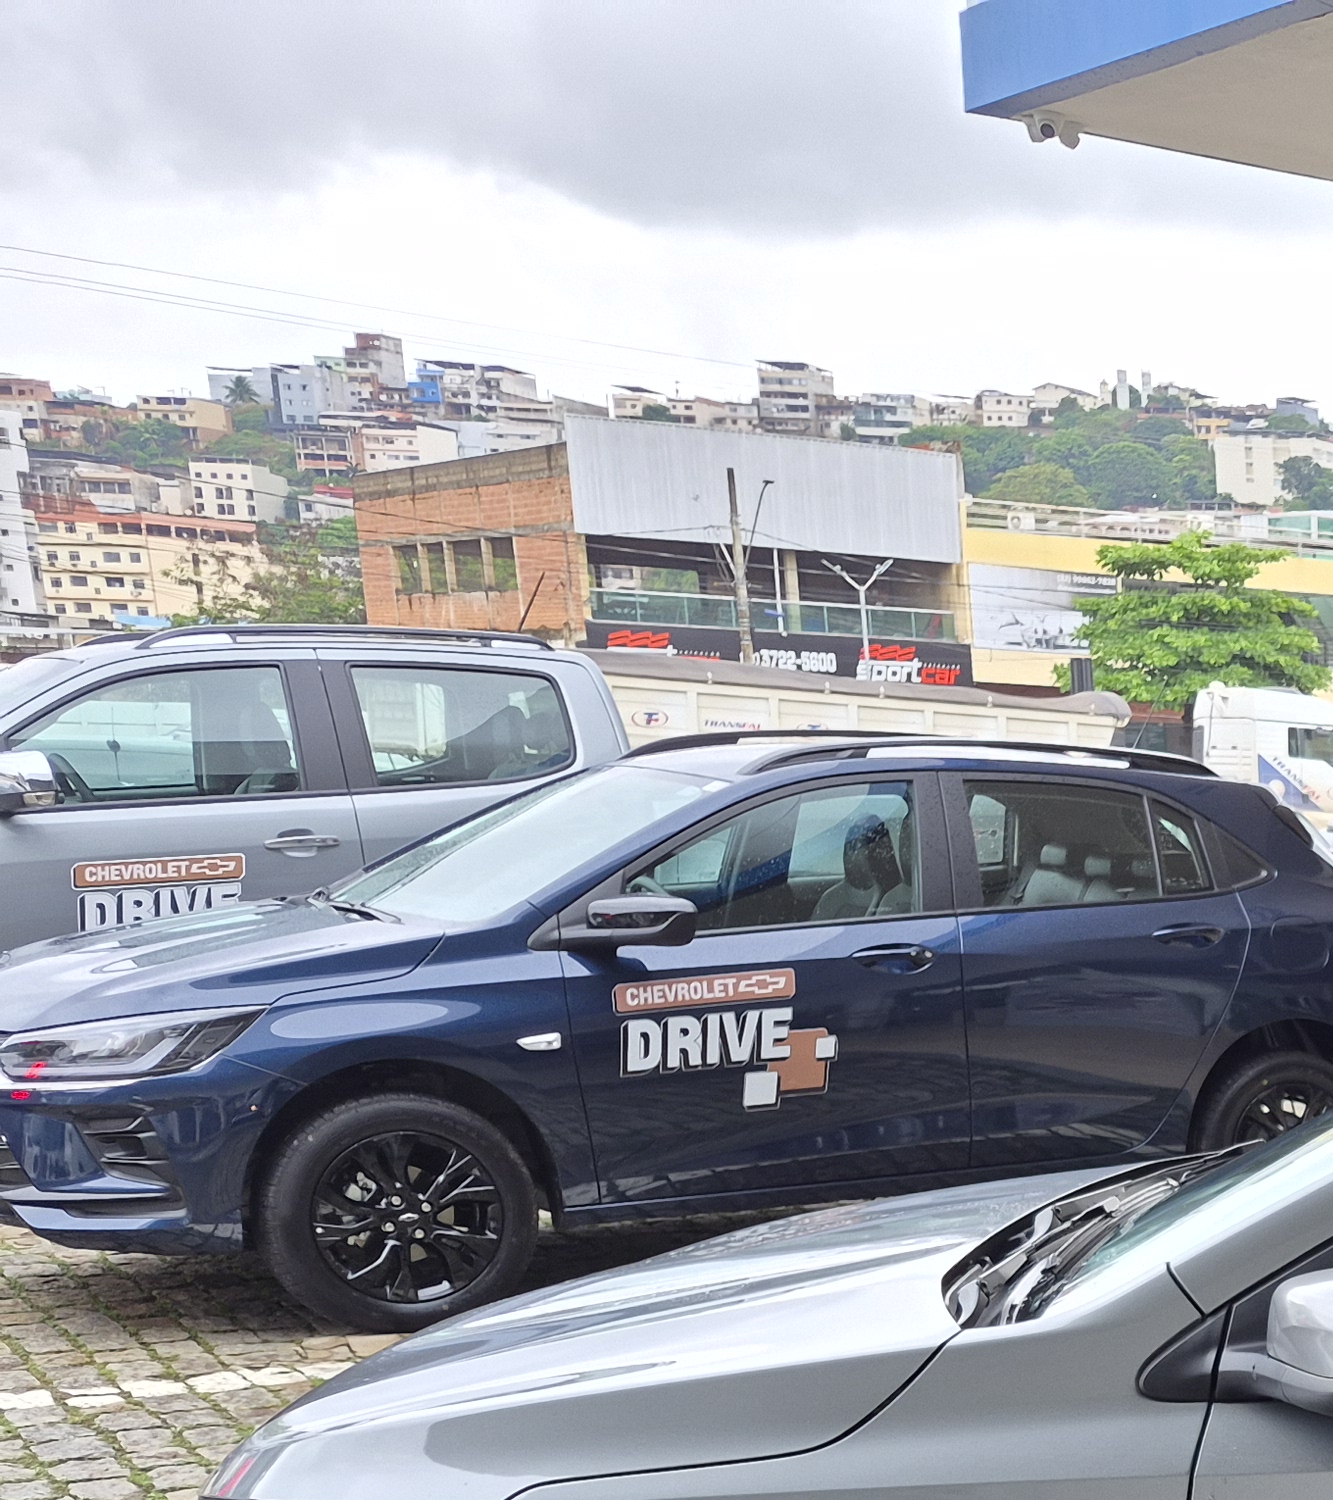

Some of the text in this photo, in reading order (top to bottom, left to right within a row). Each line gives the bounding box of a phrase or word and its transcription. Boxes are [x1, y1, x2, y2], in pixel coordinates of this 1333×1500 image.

[84, 861, 190, 882] CHEVROLET
[625, 977, 737, 1006] CHEVROLET
[620, 1006, 794, 1077] DRIVE
